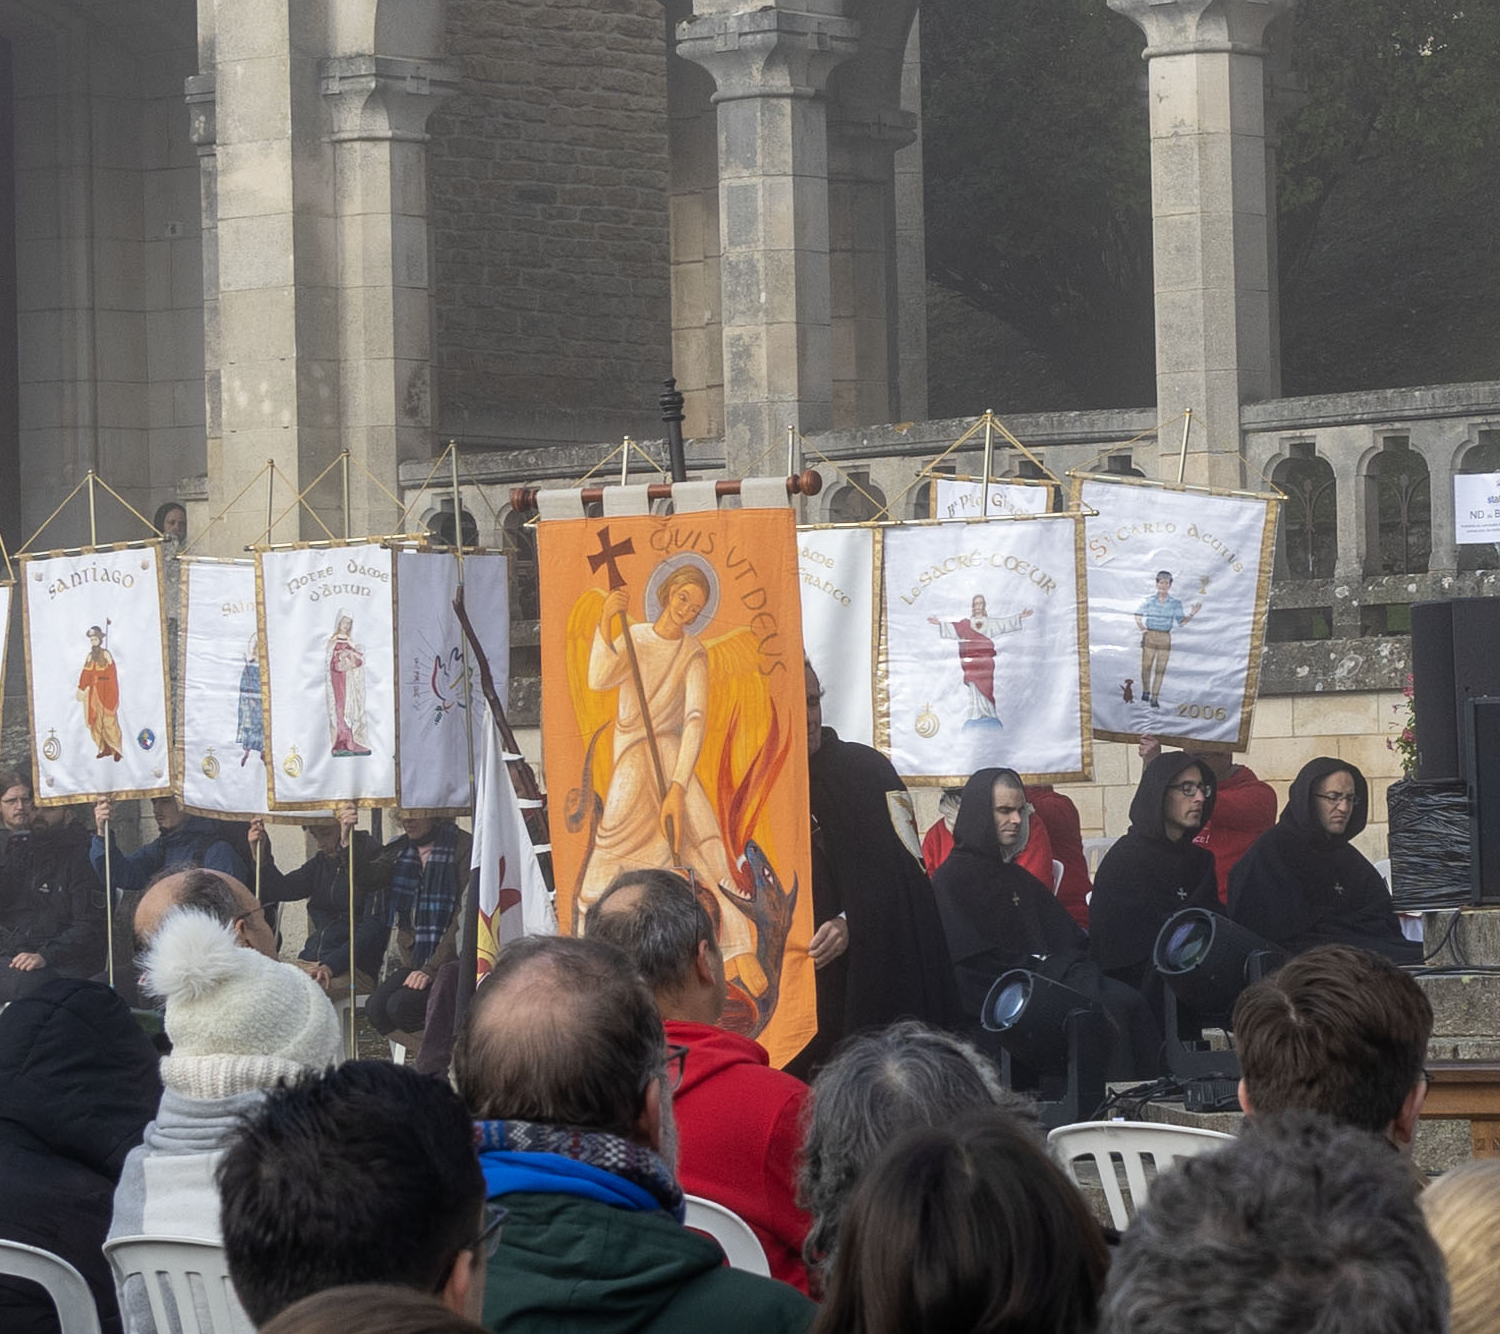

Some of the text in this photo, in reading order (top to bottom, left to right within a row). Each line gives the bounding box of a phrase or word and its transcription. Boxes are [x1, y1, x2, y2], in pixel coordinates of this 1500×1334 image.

[1470, 510, 1485, 519] ND
[650, 523, 787, 676] QUIS UT DEUS
[900, 585, 922, 605] Le
[1176, 703, 1227, 721] 2006
